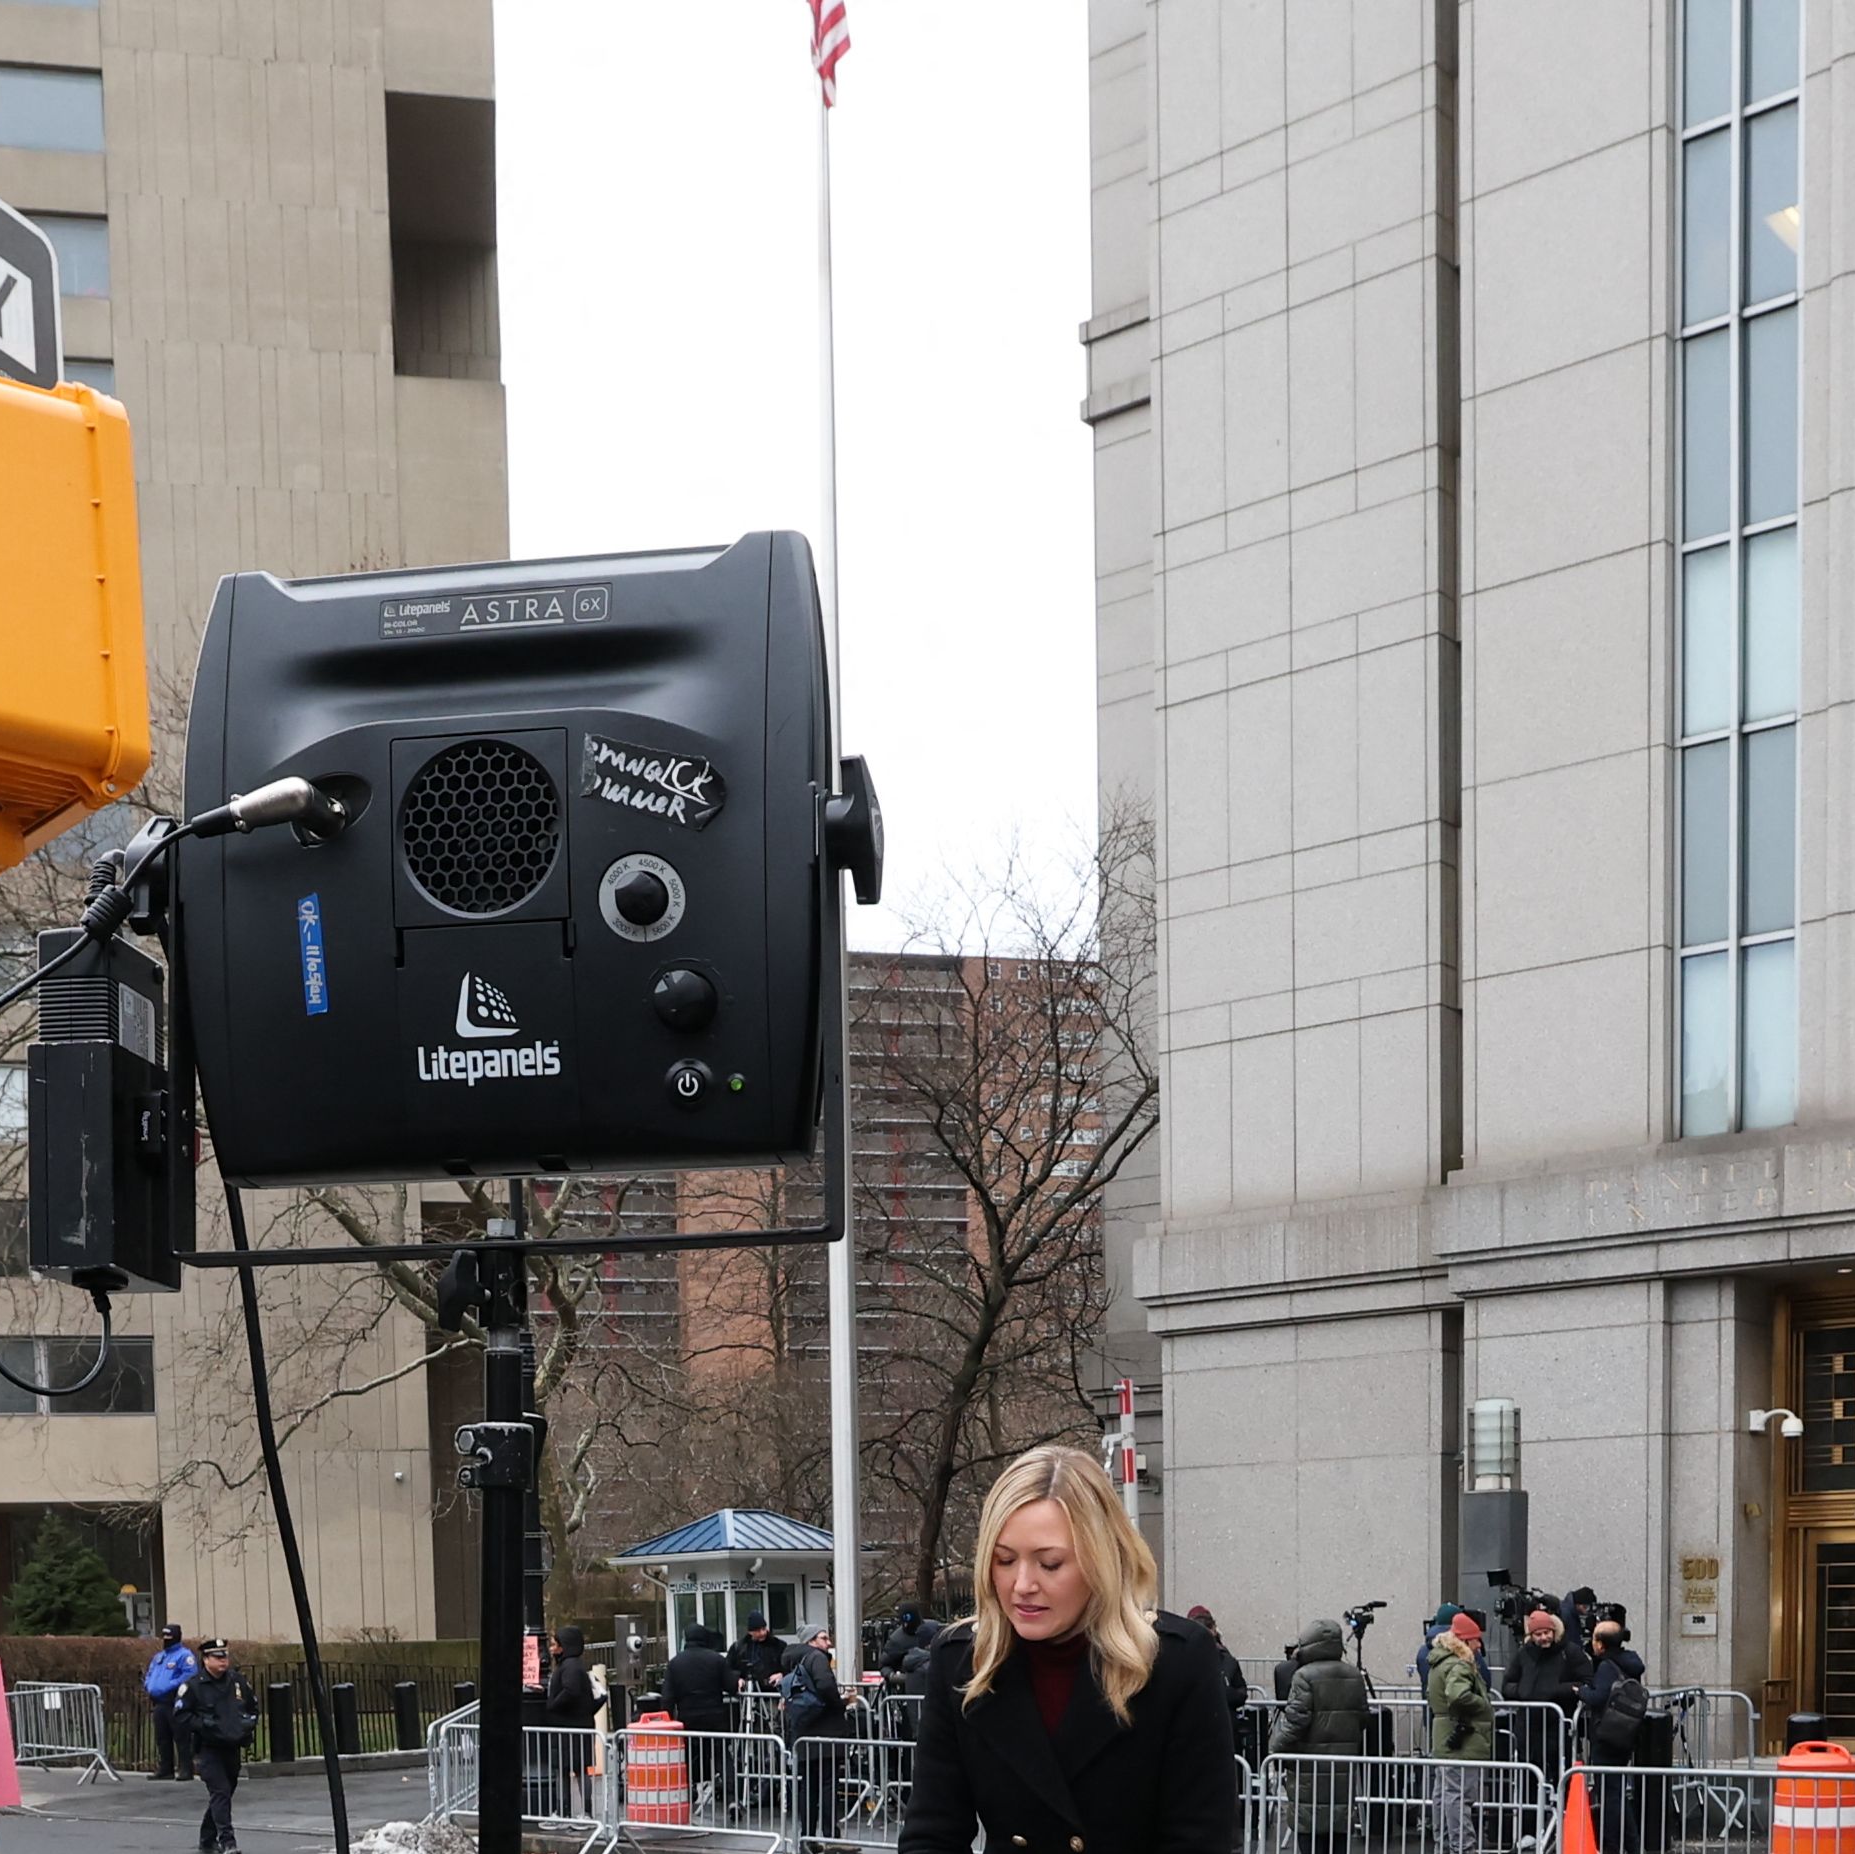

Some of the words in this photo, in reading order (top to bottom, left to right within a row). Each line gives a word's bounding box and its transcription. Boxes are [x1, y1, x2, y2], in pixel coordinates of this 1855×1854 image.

[399, 600, 450, 618] Litepanels
[461, 596, 564, 624] ASTRA
[580, 597, 601, 612] 6X
[417, 1040, 560, 1087] Litepanels
